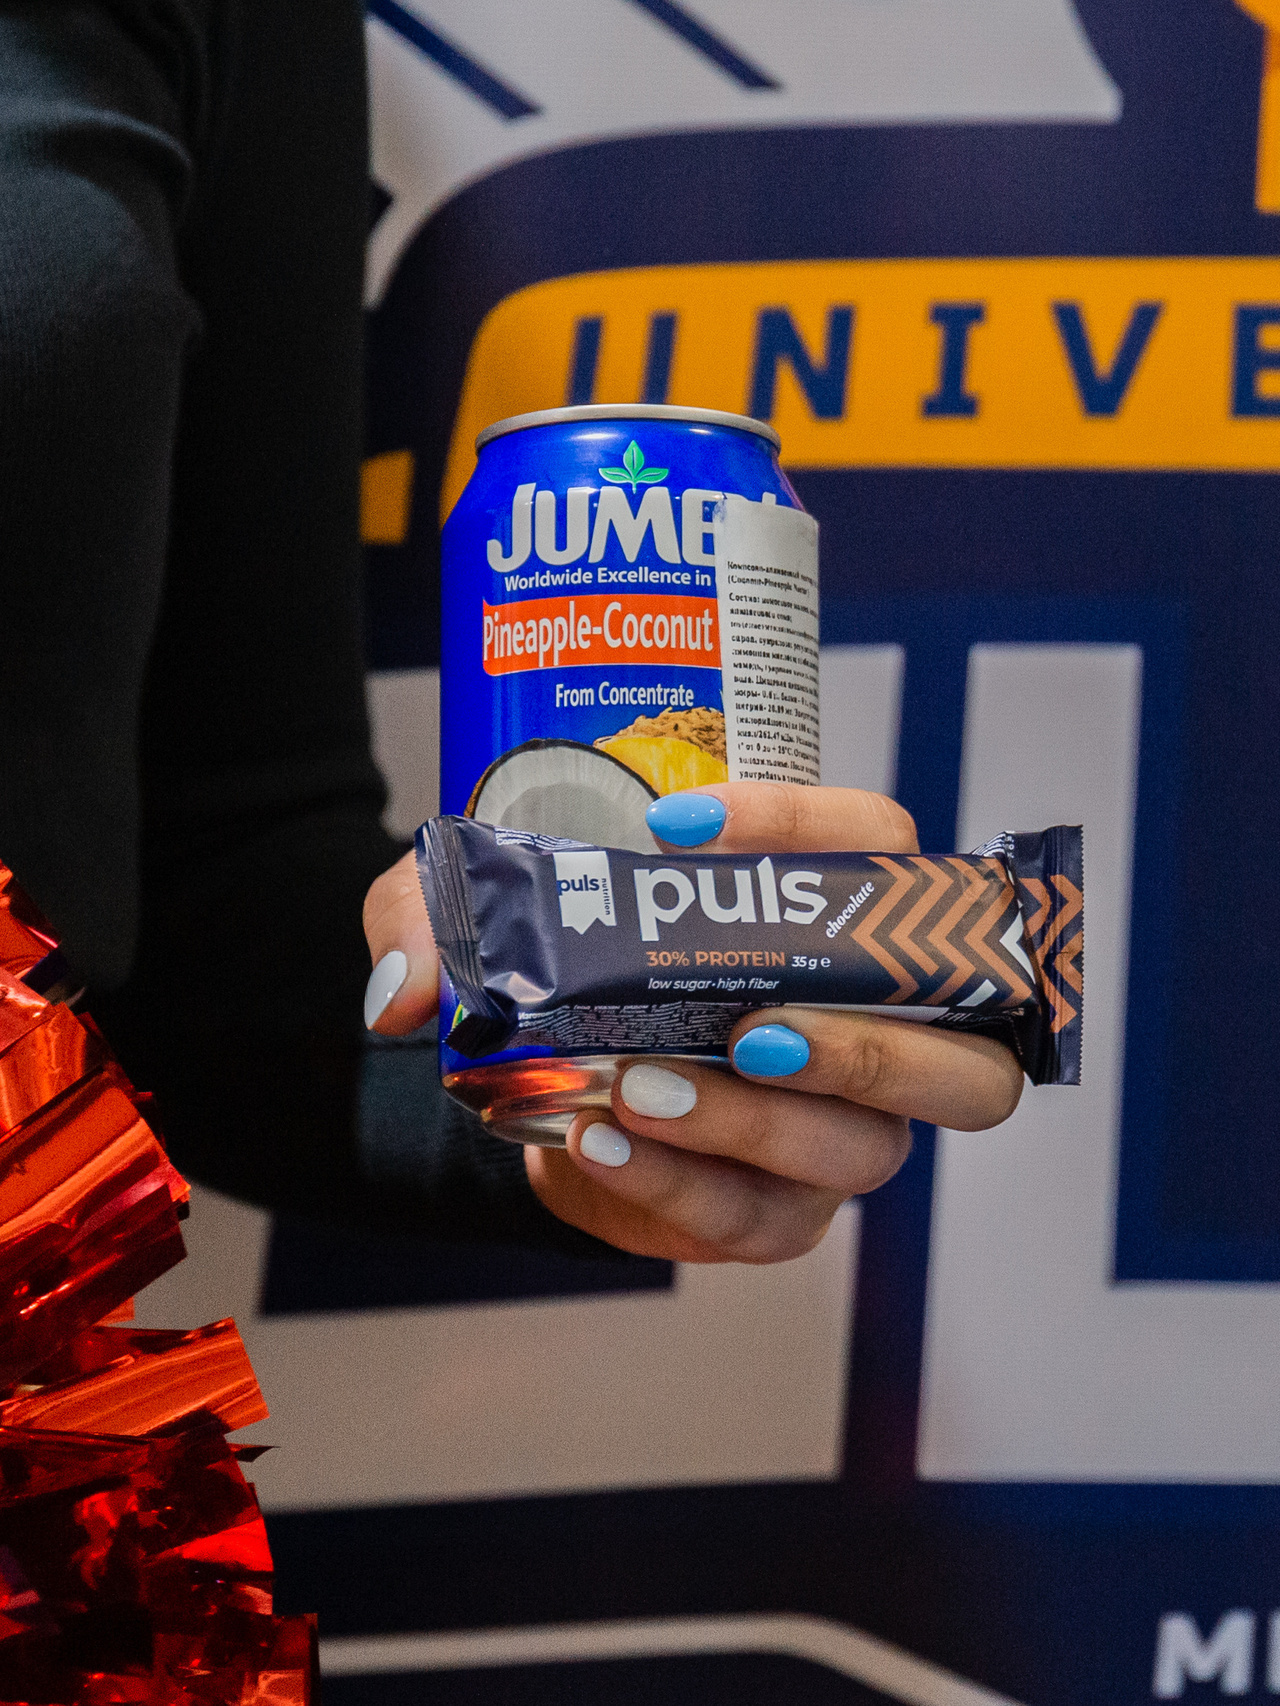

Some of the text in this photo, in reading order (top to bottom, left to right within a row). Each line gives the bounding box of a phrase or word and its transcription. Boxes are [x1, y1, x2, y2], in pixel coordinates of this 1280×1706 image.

[505, 567, 712, 592] Worldwide Excellence in
[483, 601, 713, 667] Pineapple-Coconut
[555, 681, 695, 708] From Concentrate
[556, 874, 600, 896] puls
[601, 877, 611, 916] nutrition
[633, 856, 828, 942] puls
[825, 881, 875, 939] chocolate
[646, 951, 690, 967] 30%
[695, 951, 786, 967] PROTEIN
[647, 978, 672, 990] low
[748, 978, 780, 990] fiber
